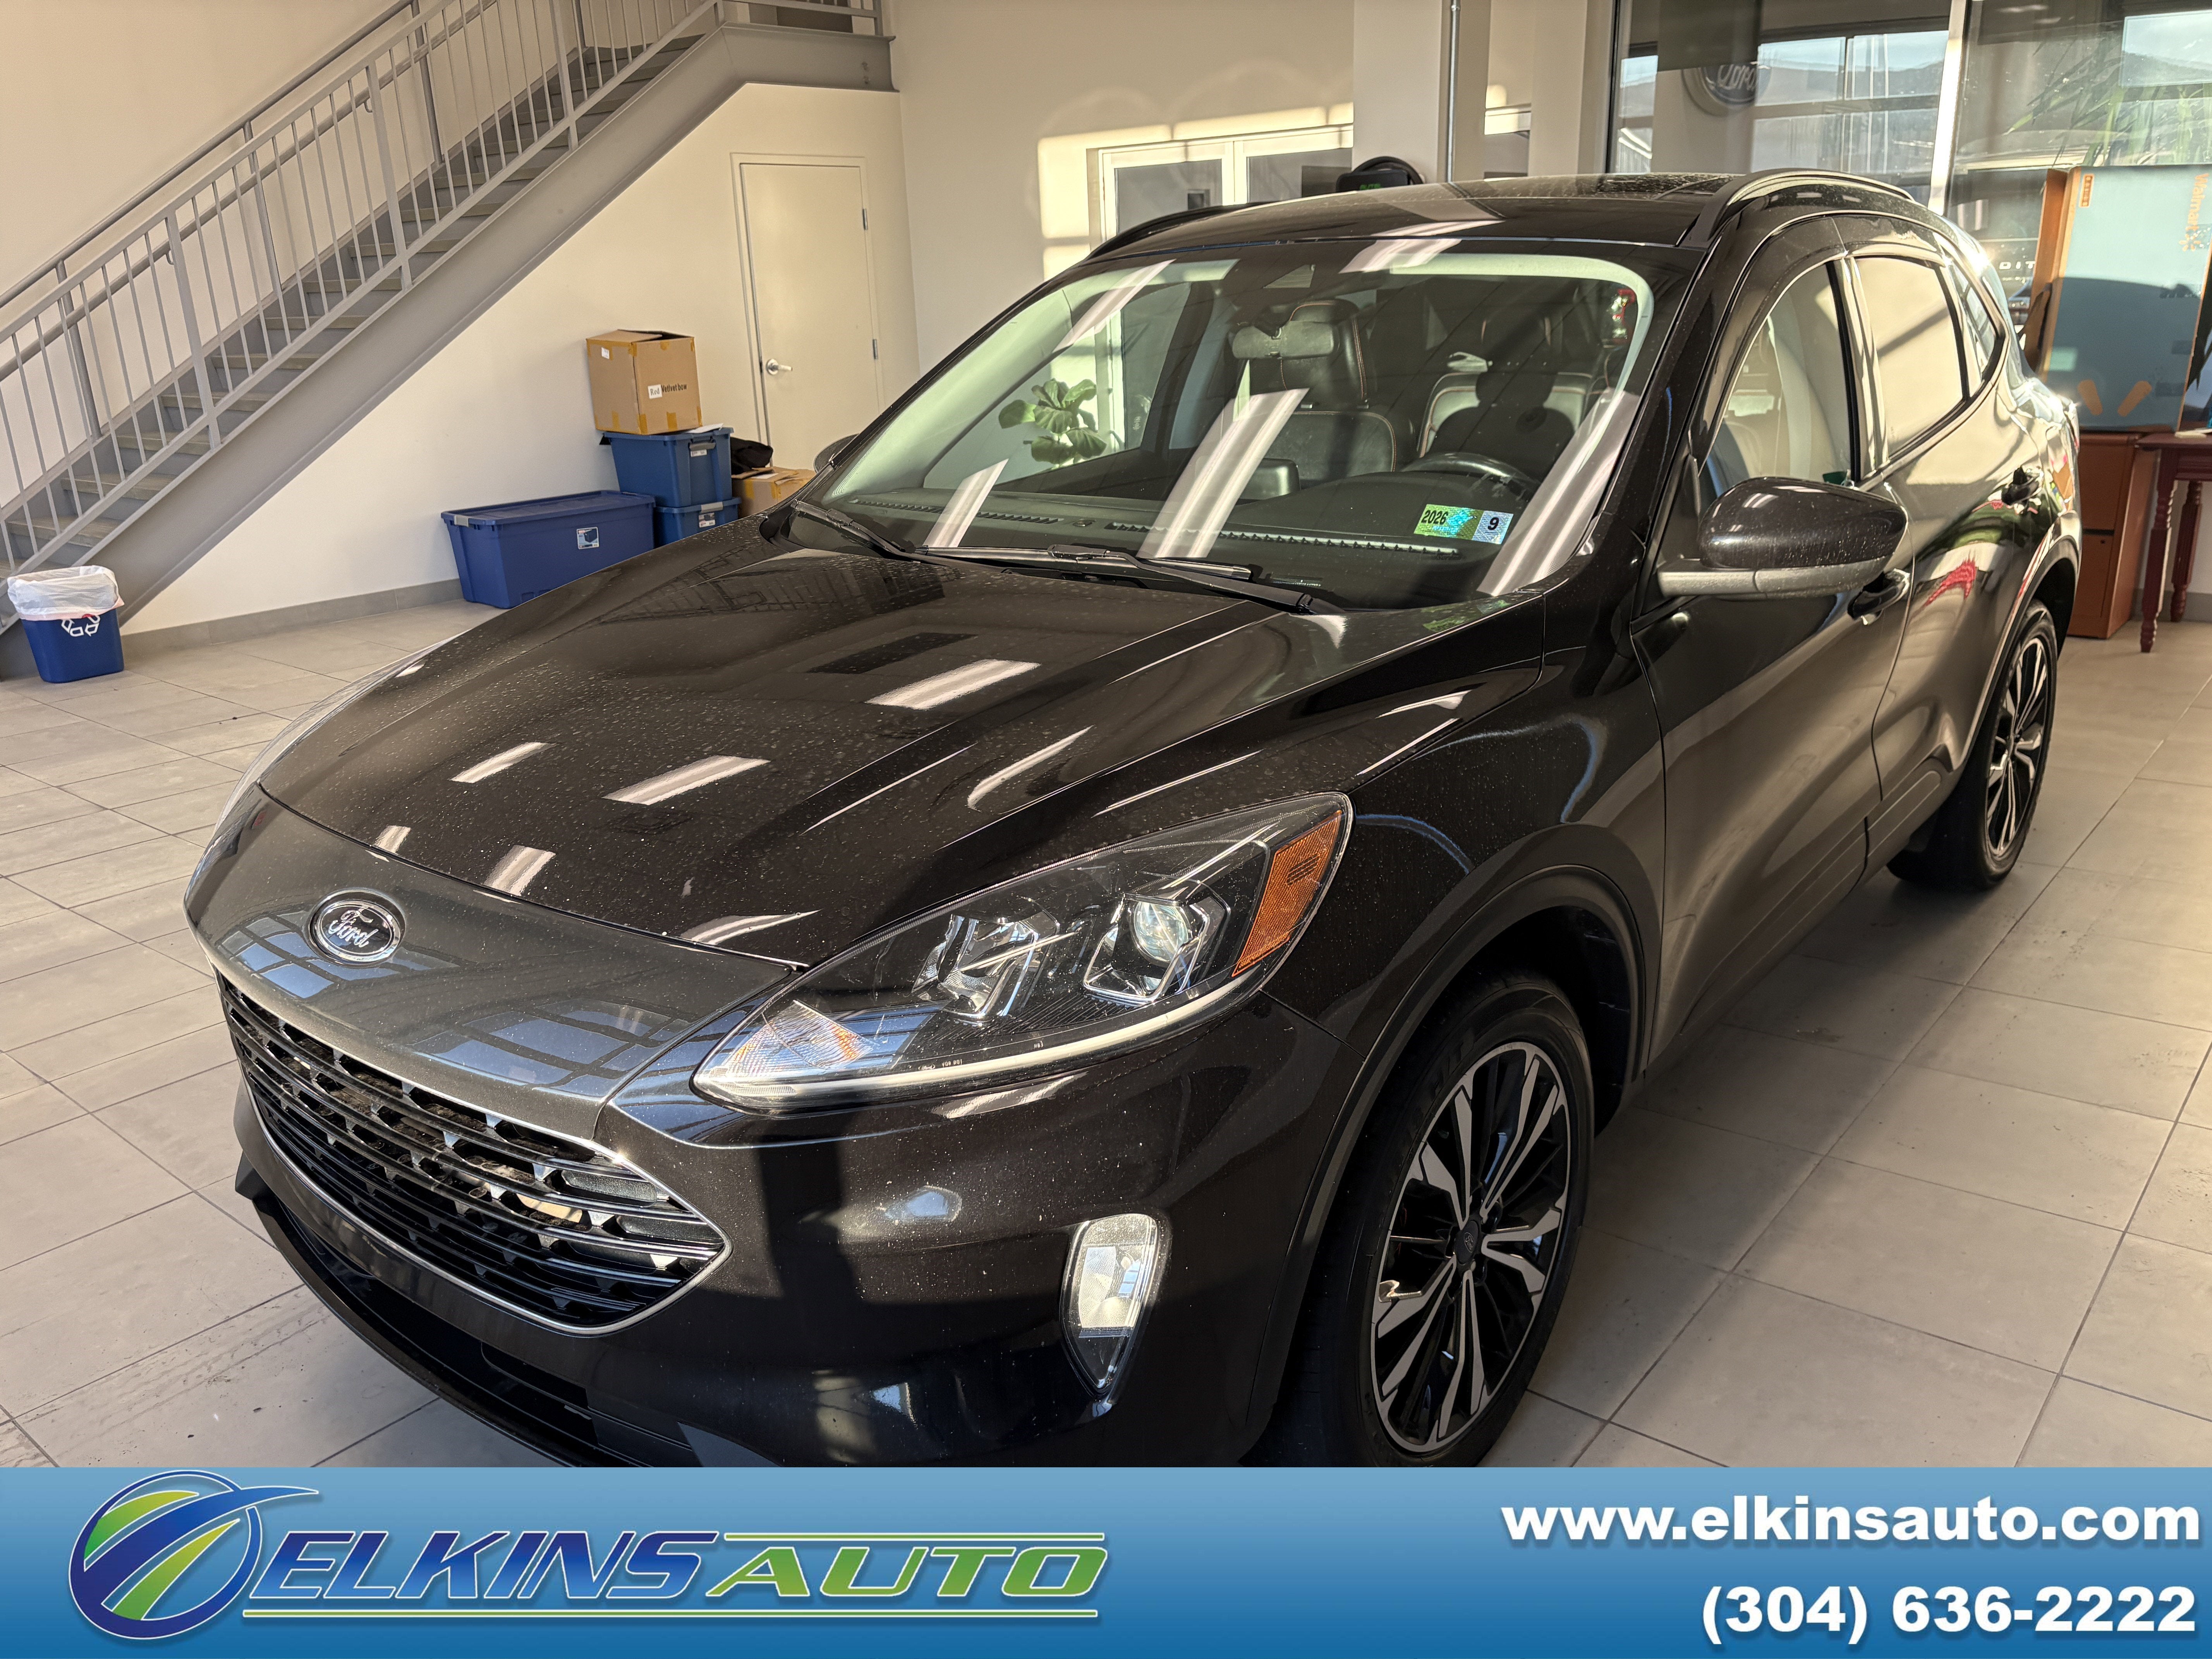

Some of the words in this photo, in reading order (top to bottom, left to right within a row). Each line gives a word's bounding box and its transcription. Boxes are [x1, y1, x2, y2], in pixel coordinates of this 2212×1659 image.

[2185, 173, 2209, 231] Walmart
[650, 387, 660, 396] Red
[1421, 510, 1448, 525] 2026
[1487, 517, 1499, 531] 9
[328, 908, 379, 948] Ford
